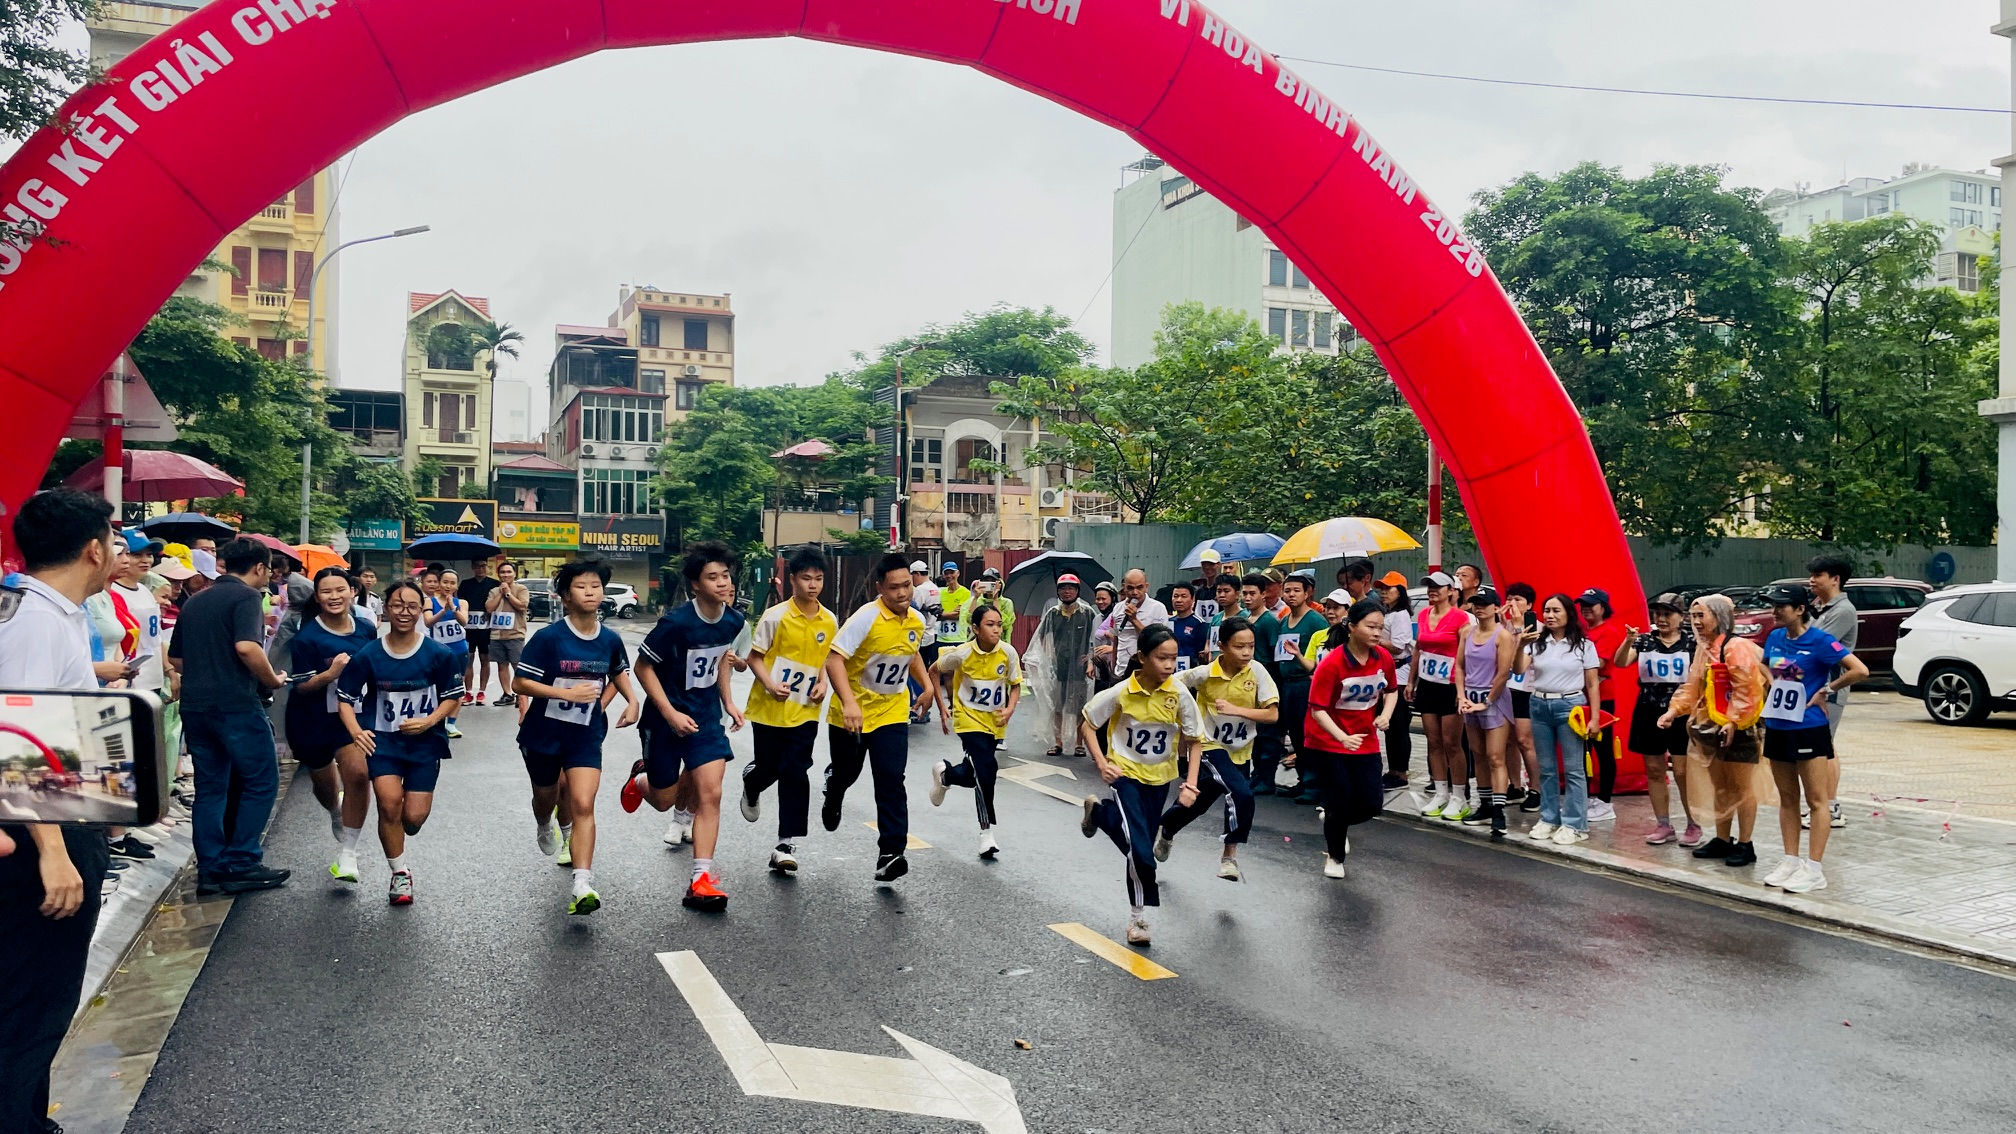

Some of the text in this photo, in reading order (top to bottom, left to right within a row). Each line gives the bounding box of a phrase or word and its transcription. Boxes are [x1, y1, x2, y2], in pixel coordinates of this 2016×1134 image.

[130, 30, 234, 112] GIẢI
[1419, 203, 1484, 278] 2026
[582, 532, 618, 545] NINH
[621, 533, 661, 546] SEOUL
[597, 544, 619, 552] HAIR
[467, 614, 486, 625] 203
[437, 623, 463, 638] 169
[1423, 658, 1449, 678] 184
[1645, 657, 1684, 678] 169
[969, 685, 1002, 706] 126
[1772, 687, 1799, 711] 99
[383, 694, 434, 723] 344
[1126, 727, 1168, 755] 123
[1213, 721, 1248, 745] 124
